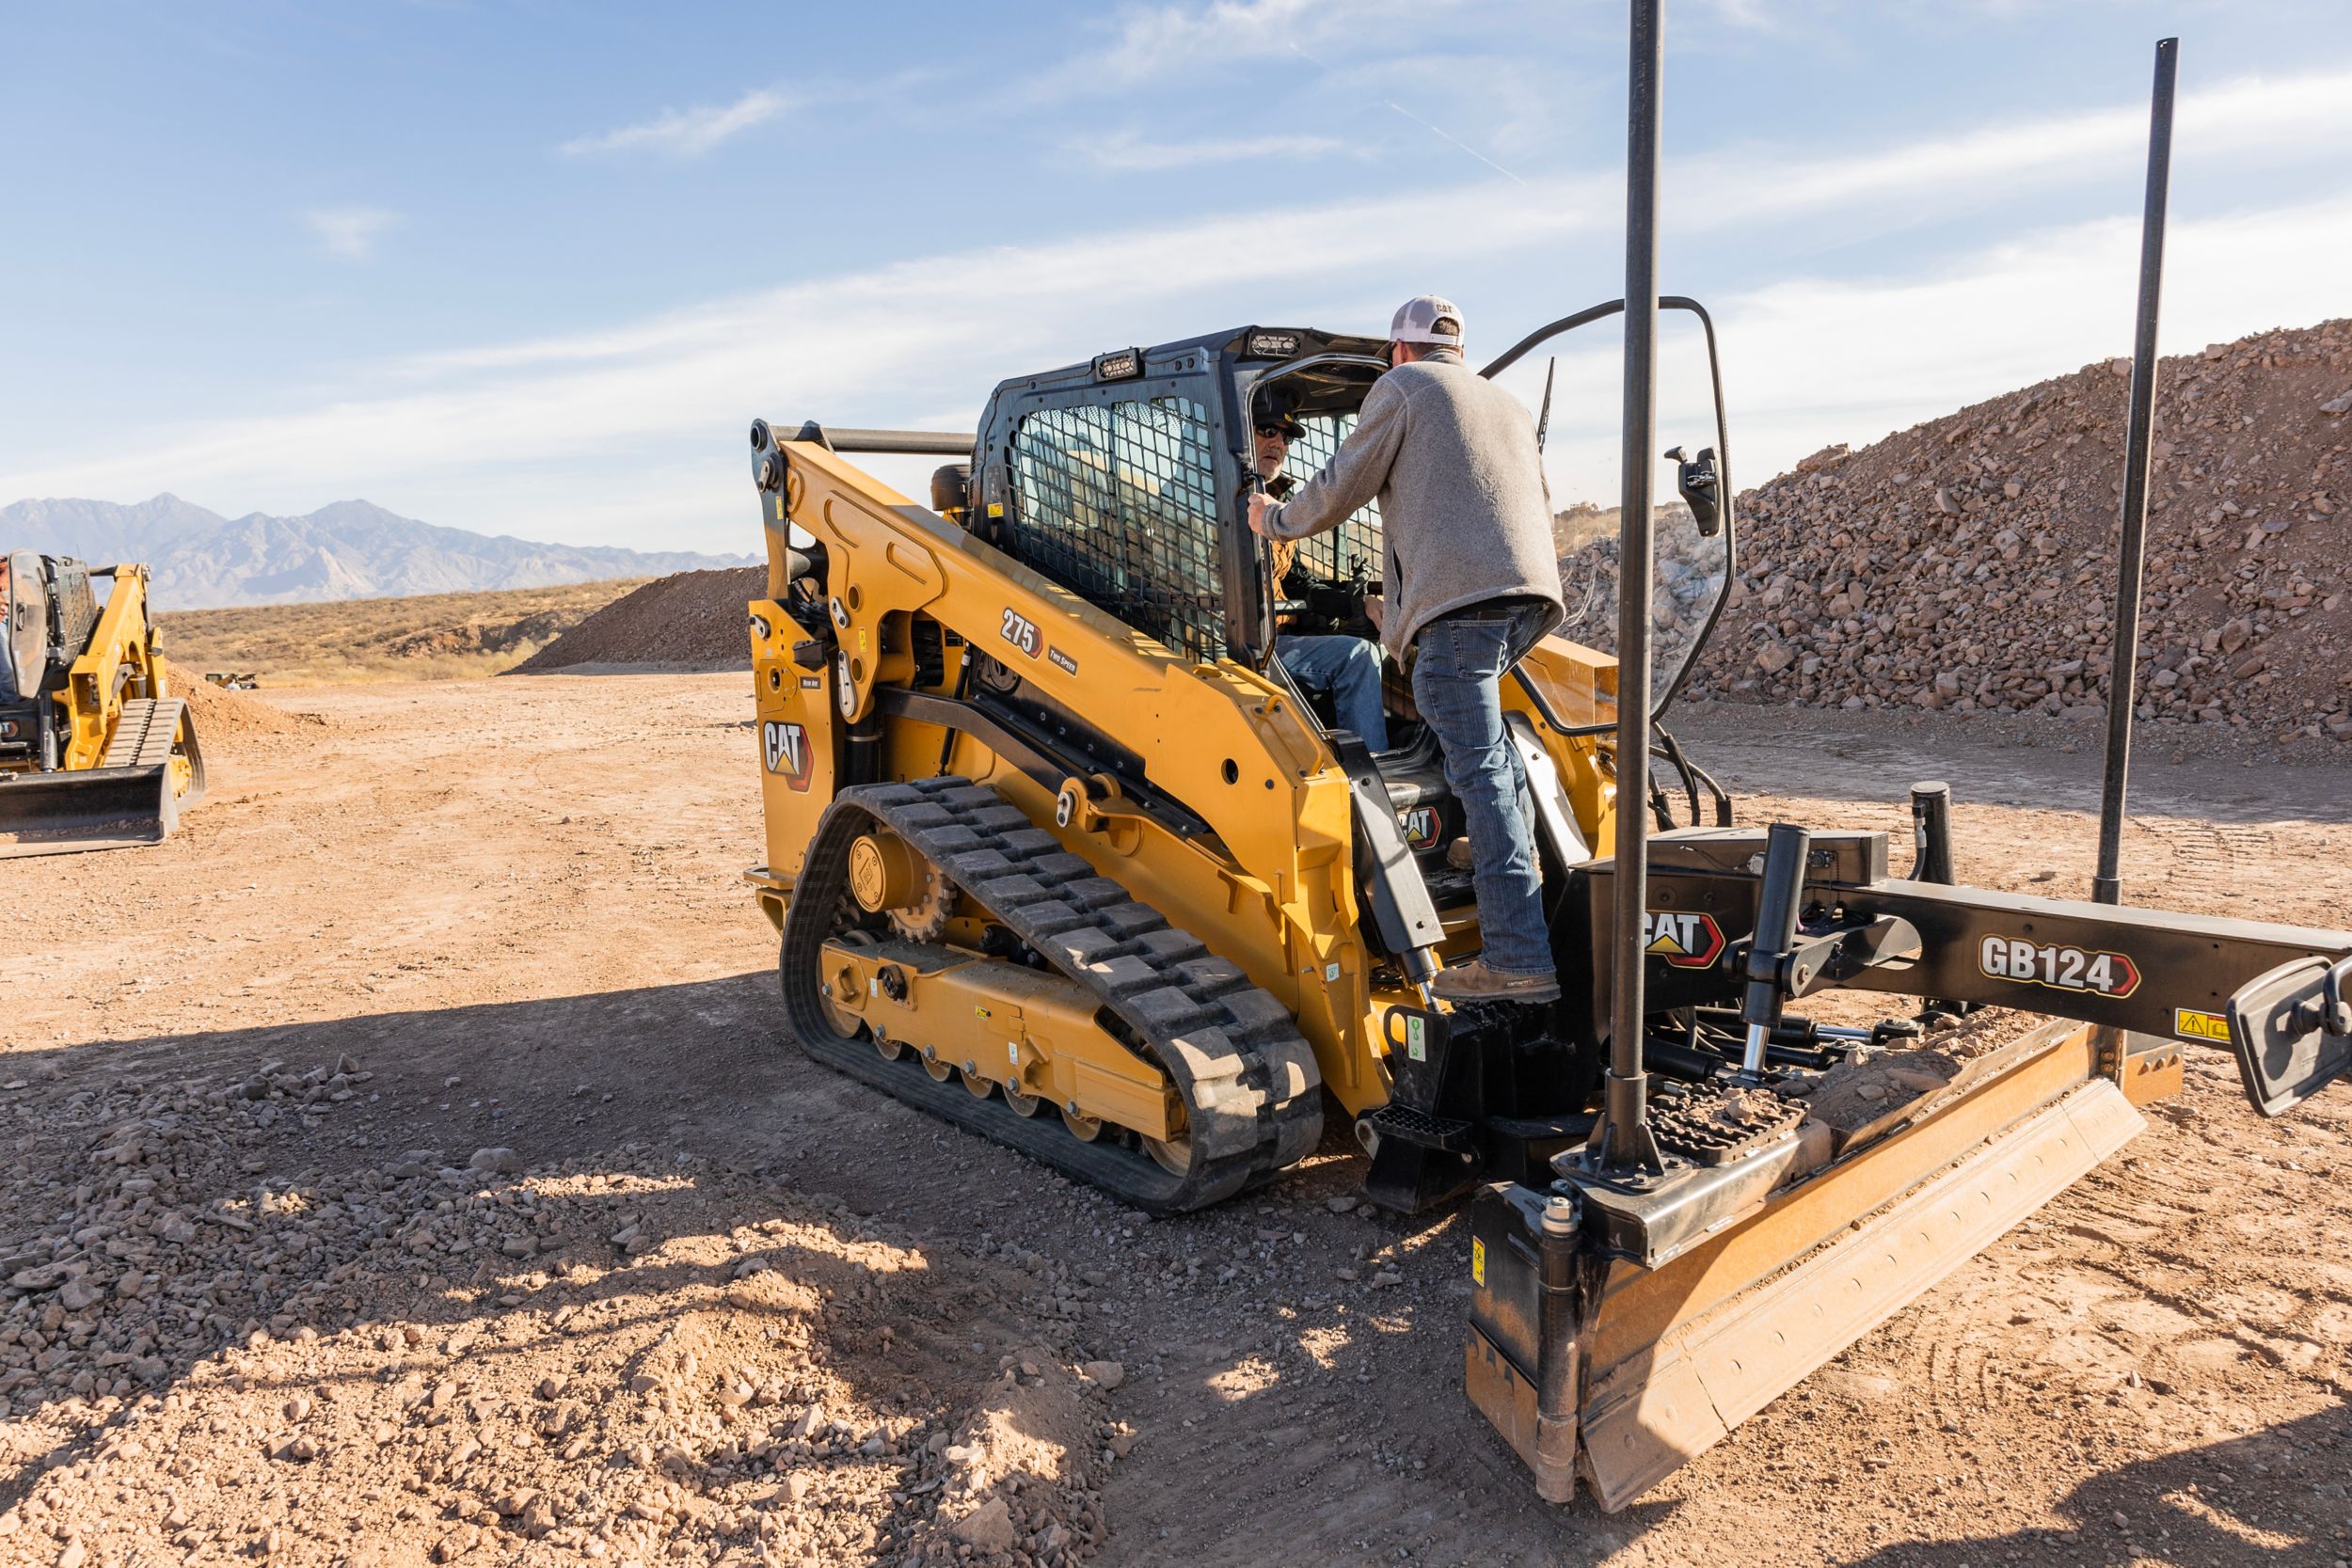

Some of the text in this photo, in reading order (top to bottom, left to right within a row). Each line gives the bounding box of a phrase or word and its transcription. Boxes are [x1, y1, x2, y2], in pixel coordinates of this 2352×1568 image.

[1436, 304, 1453, 313] CAT
[1001, 609, 1035, 653] 275
[764, 721, 800, 776] CAT
[1982, 937, 2114, 992] GB124
